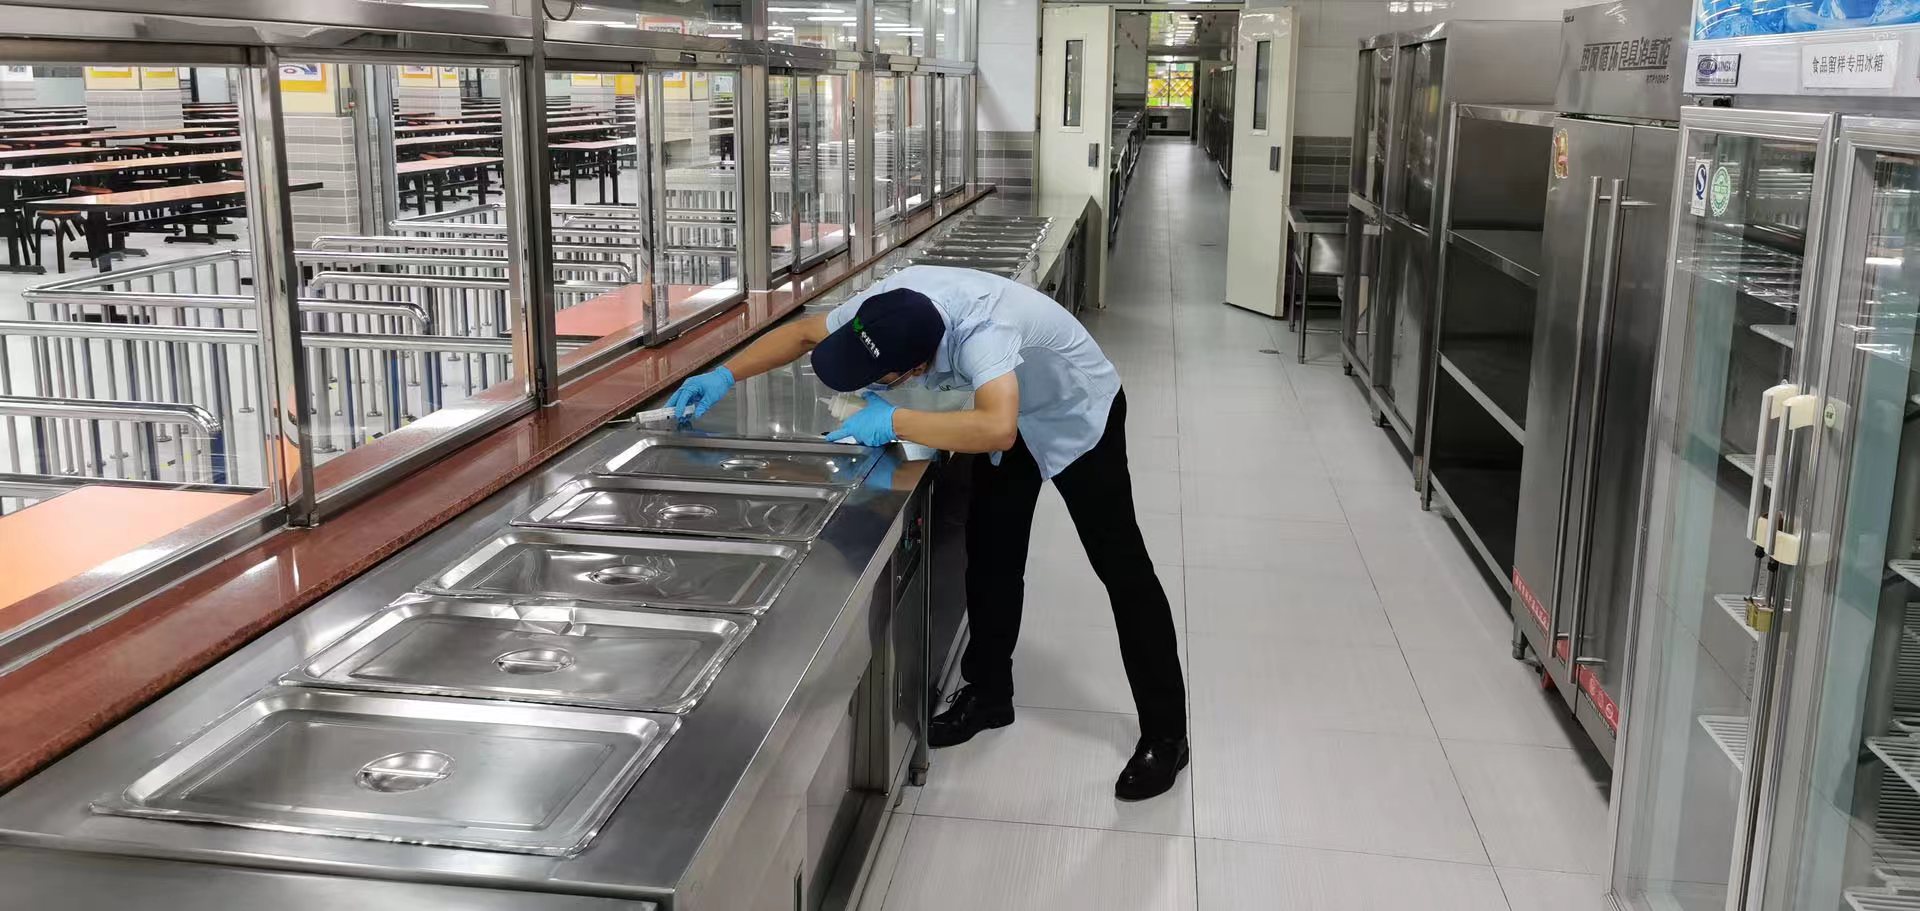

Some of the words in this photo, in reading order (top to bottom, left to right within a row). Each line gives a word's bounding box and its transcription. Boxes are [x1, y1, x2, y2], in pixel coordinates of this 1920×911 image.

[1812, 54, 1884, 74] 食品留样专用冰箱
